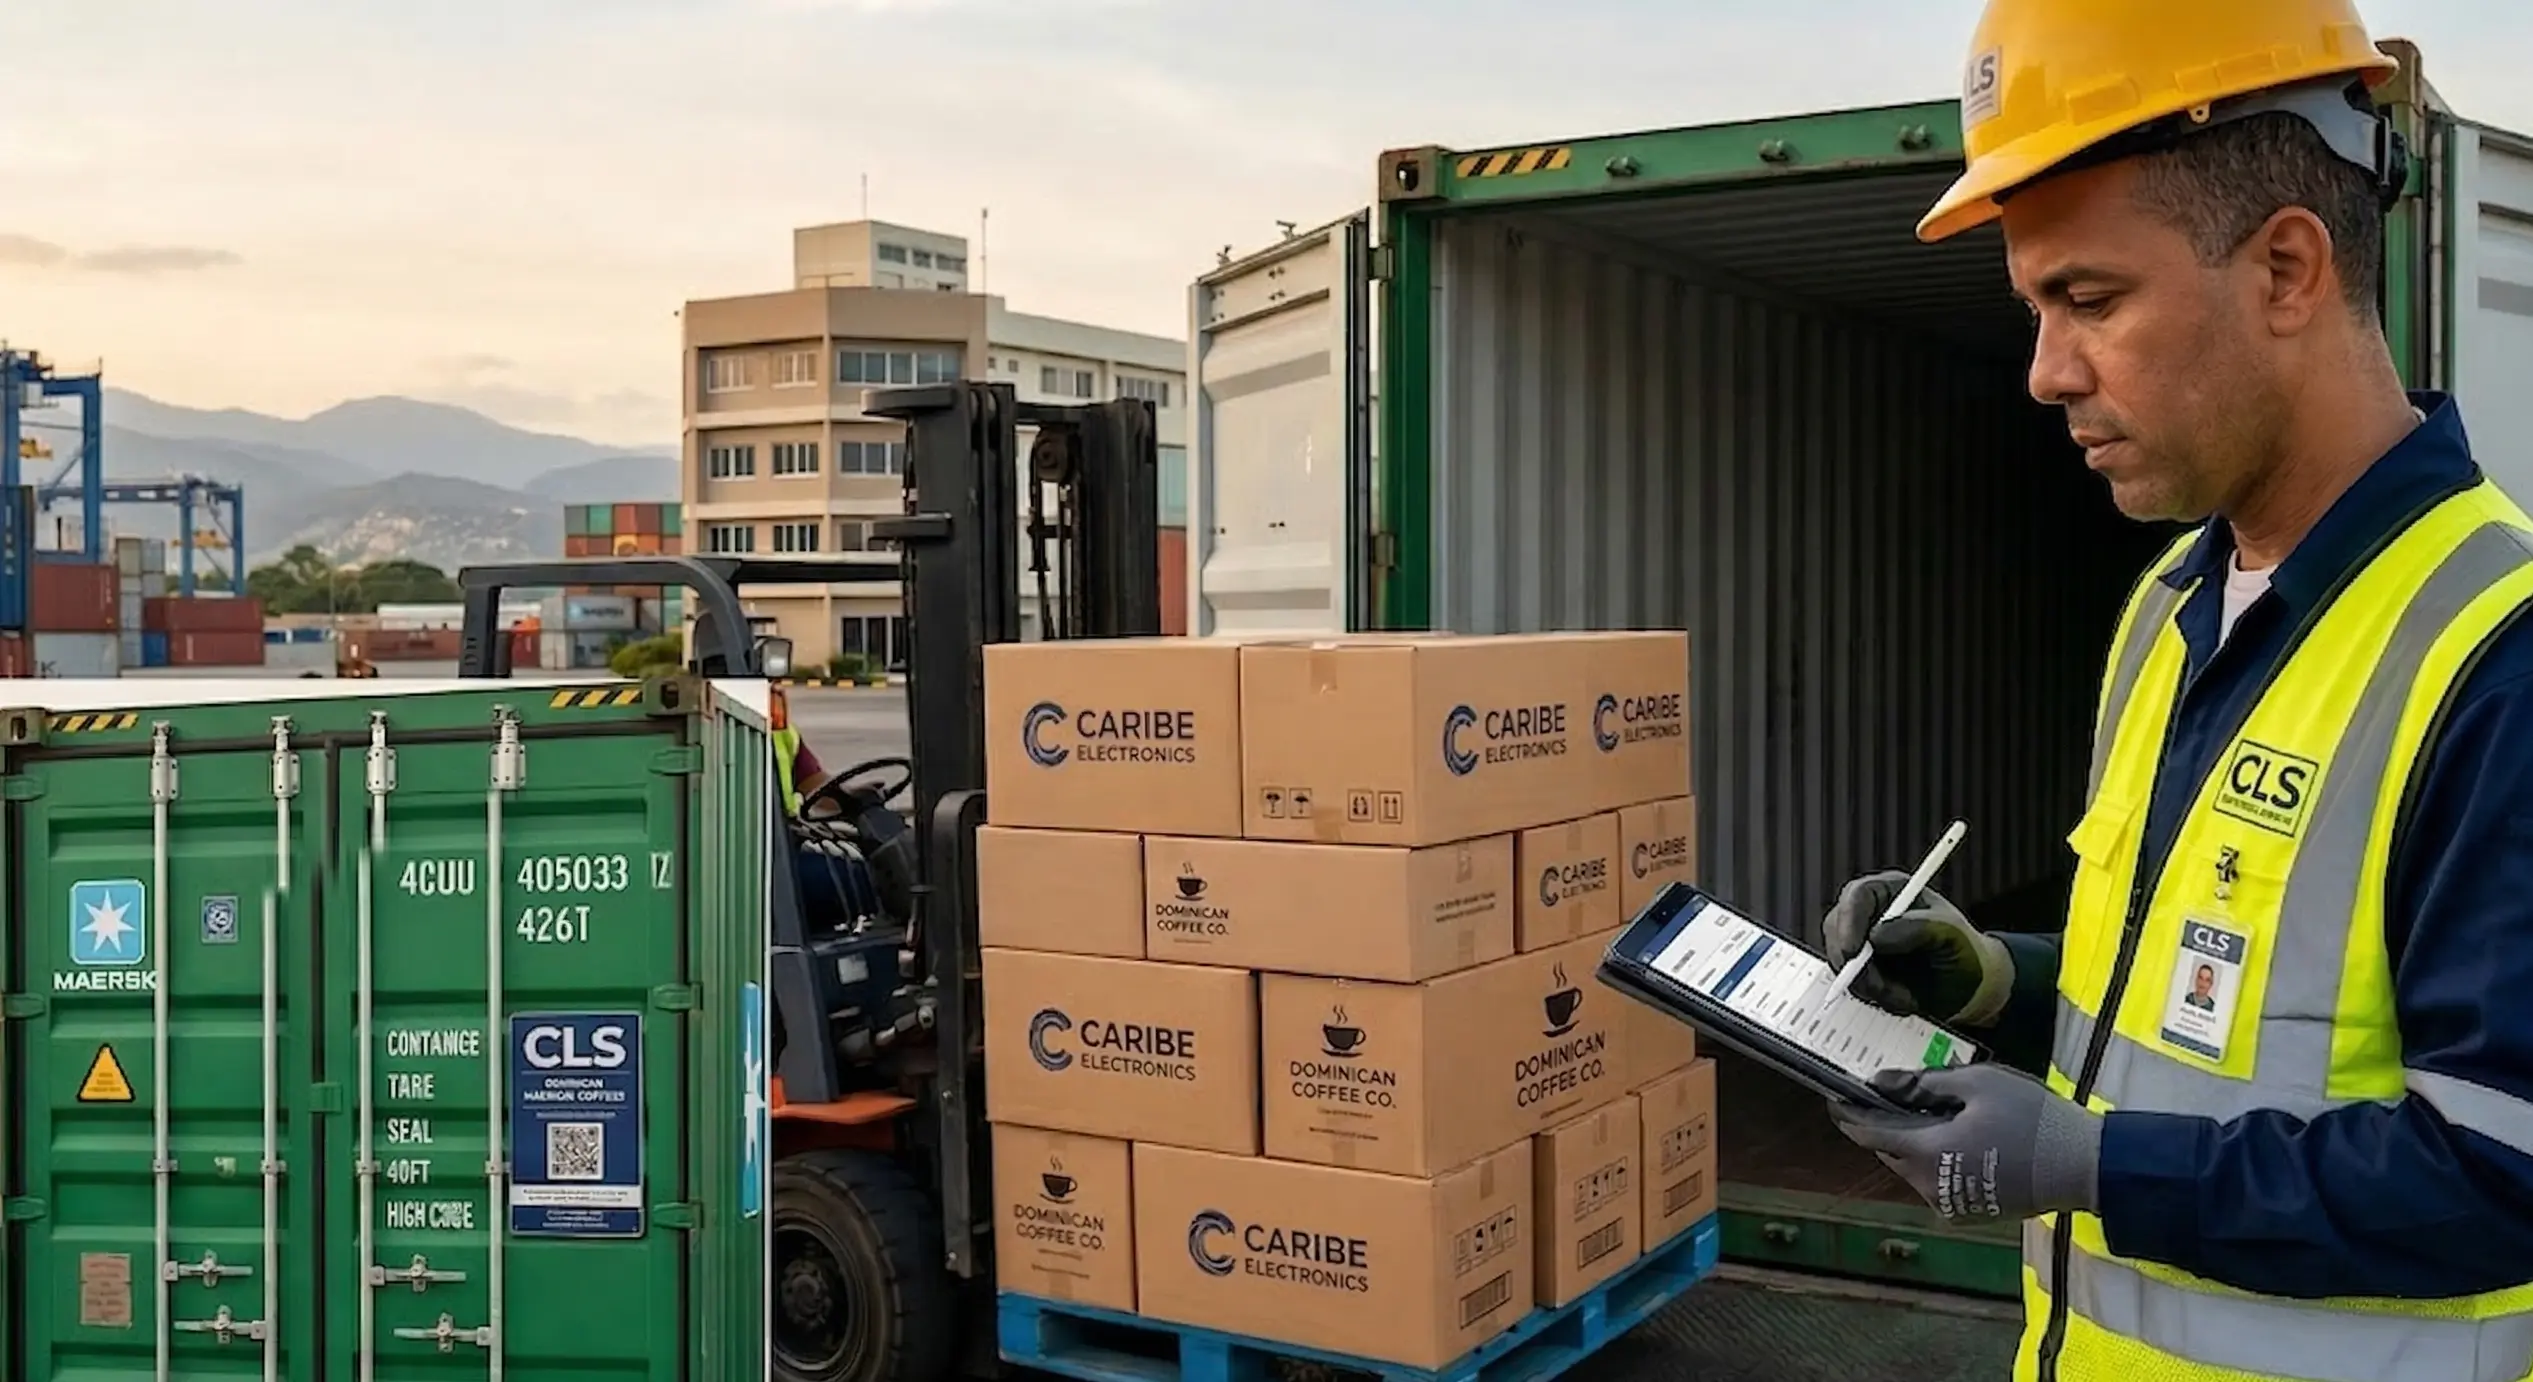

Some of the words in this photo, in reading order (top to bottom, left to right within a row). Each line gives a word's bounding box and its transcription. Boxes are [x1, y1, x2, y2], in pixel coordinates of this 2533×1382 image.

[1964, 55, 1995, 97] LS
[1623, 694, 1681, 722] CARIBE
[1077, 711, 1195, 740] CARIBE
[1485, 705, 1566, 740] CARIBE
[1077, 745, 1195, 763] ELECTRONICS
[1486, 739, 1567, 764] ELECTRONICS
[2231, 754, 2306, 810] CLS
[1650, 836, 1687, 858] CARIBE
[399, 860, 474, 895] 4CUU
[517, 855, 628, 892] 405033
[1562, 858, 1607, 884] CARIBE
[516, 906, 590, 942] 426T
[2193, 927, 2231, 953] CLS
[53, 971, 157, 990] MAERSK
[523, 1026, 627, 1069] CLS
[1080, 1020, 1195, 1059] CARIBE
[1081, 1053, 1196, 1081] ELECTRONICS
[1515, 1029, 1606, 1082] DOMINICAN
[387, 1073, 434, 1100] TARE
[1291, 1061, 1395, 1086] DOMINICAN
[1517, 1067, 1577, 1107] COFFEE
[1580, 1059, 1605, 1082] CO.
[1292, 1082, 1360, 1103] COFFEE
[1365, 1090, 1397, 1109] CO.
[387, 1117, 433, 1144] SEAL
[386, 1158, 431, 1184] 40FT
[387, 1201, 426, 1228] HIGH
[1014, 1203, 1104, 1232] DOMNCAN
[1080, 1232, 1105, 1250] CO.
[1244, 1224, 1368, 1269] CARIBE
[1245, 1258, 1369, 1293] ELECTRONICS
